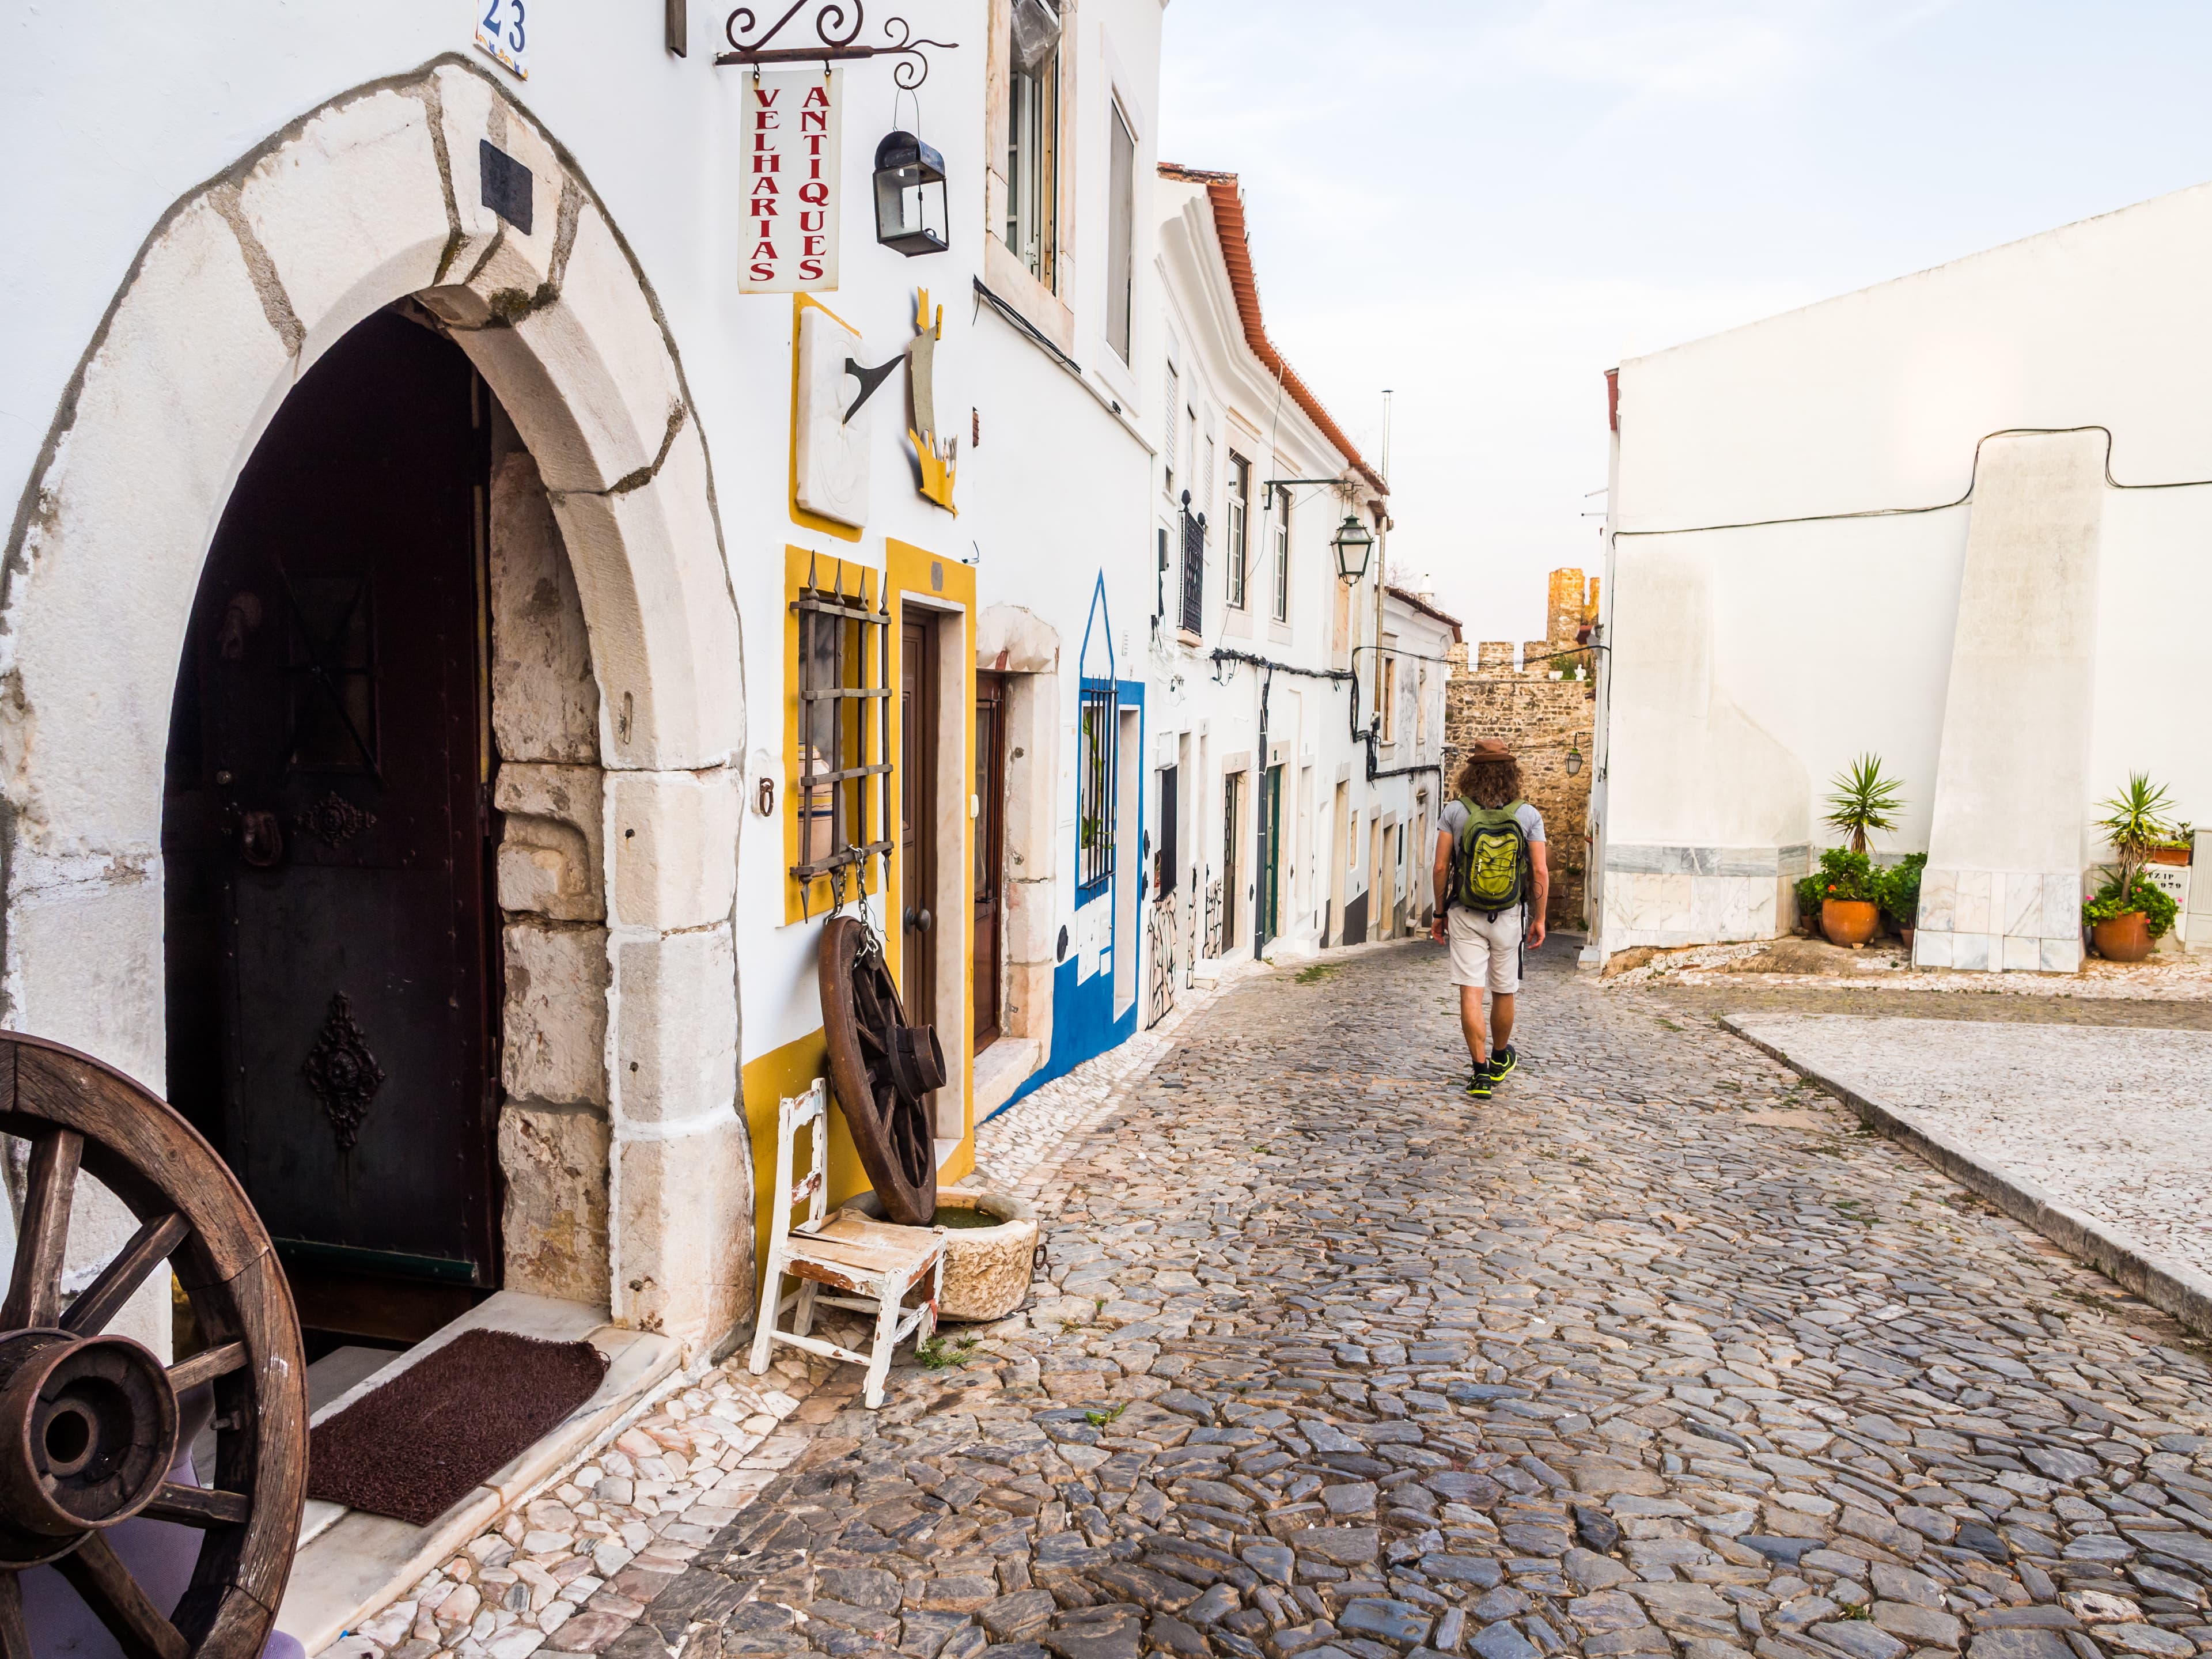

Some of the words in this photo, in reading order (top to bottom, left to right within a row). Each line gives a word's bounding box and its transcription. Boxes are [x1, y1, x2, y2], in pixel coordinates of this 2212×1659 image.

[483, 0, 525, 52] 23
[749, 89, 781, 281] VELHARIAS
[798, 86, 831, 280] ANTIQUES
